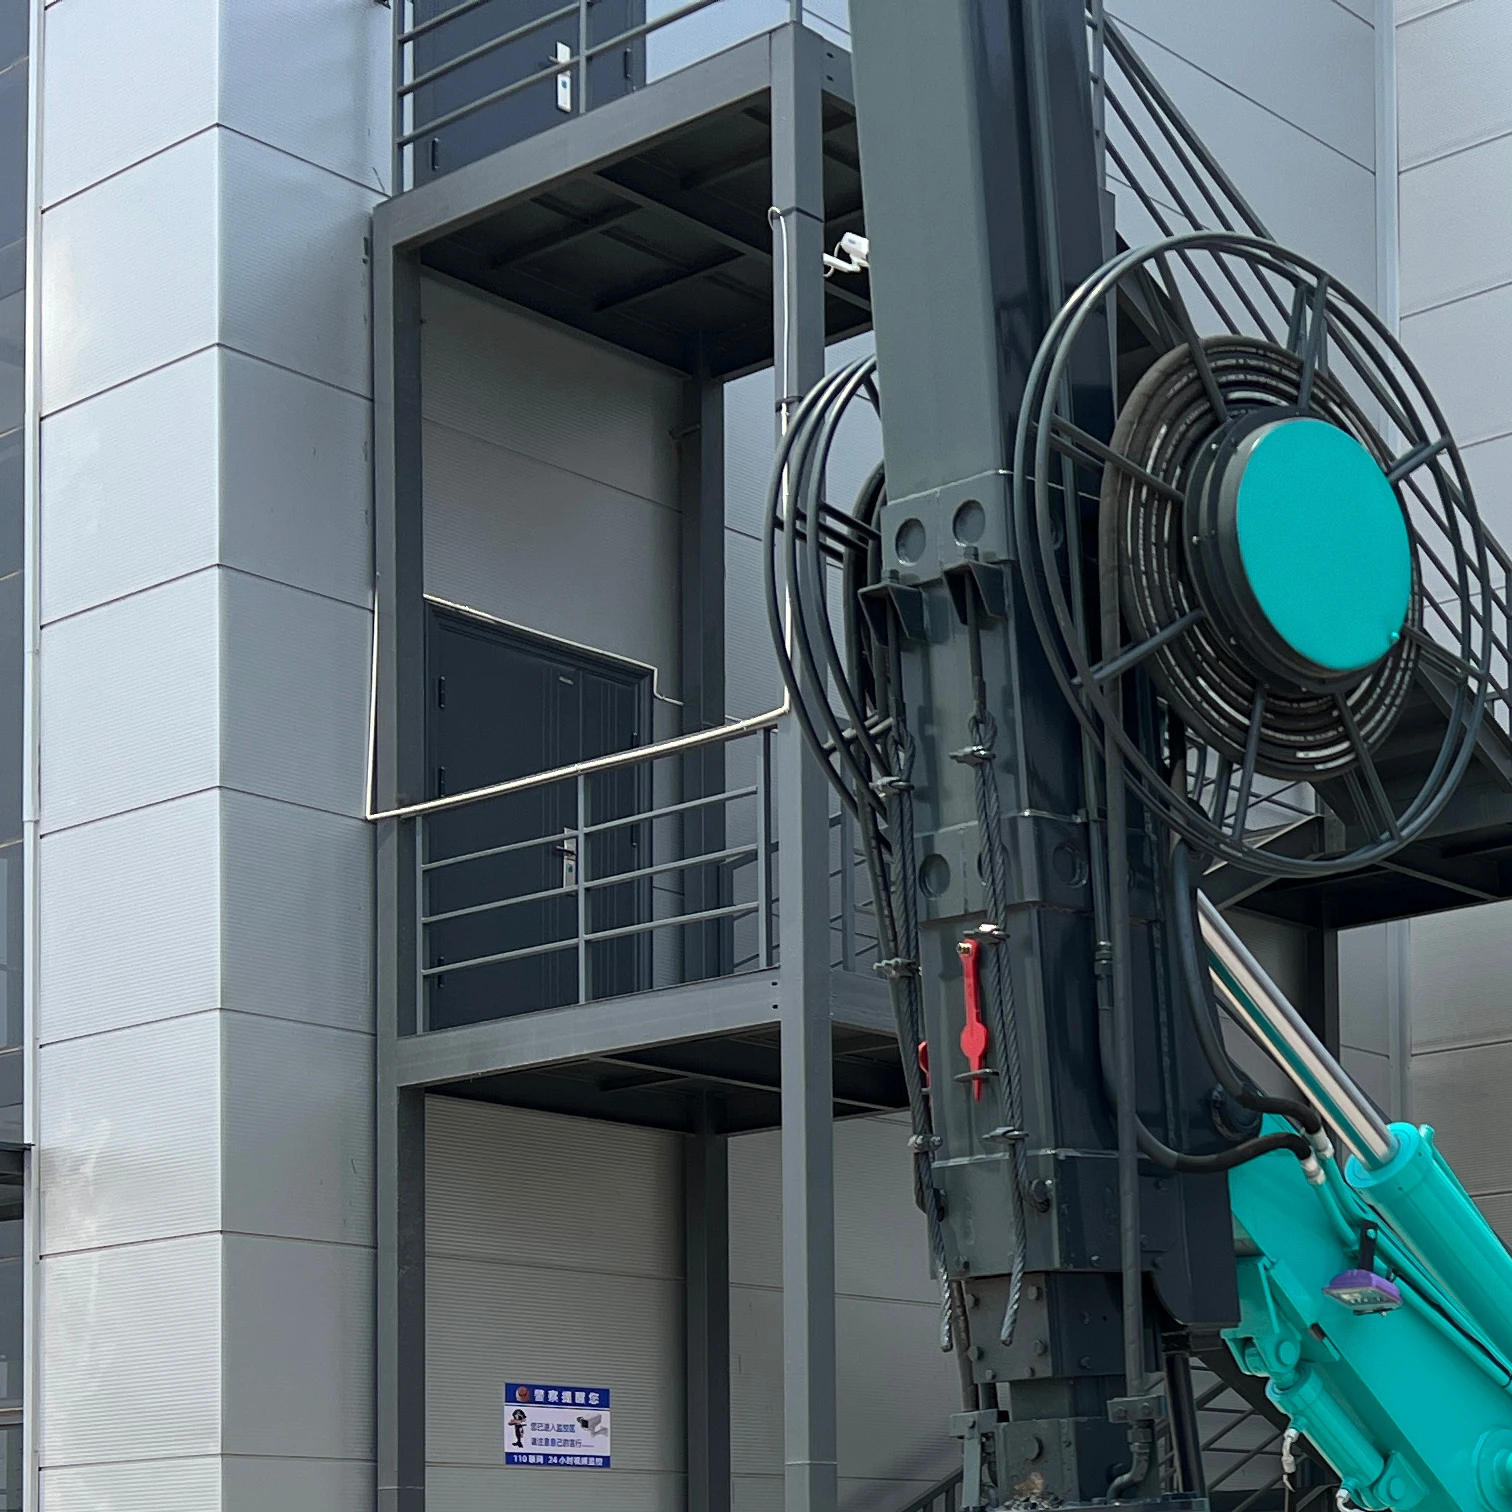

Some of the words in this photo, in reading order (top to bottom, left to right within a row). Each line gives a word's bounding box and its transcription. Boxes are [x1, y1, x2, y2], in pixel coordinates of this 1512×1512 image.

[534, 1389, 599, 1404] 警察提醒您
